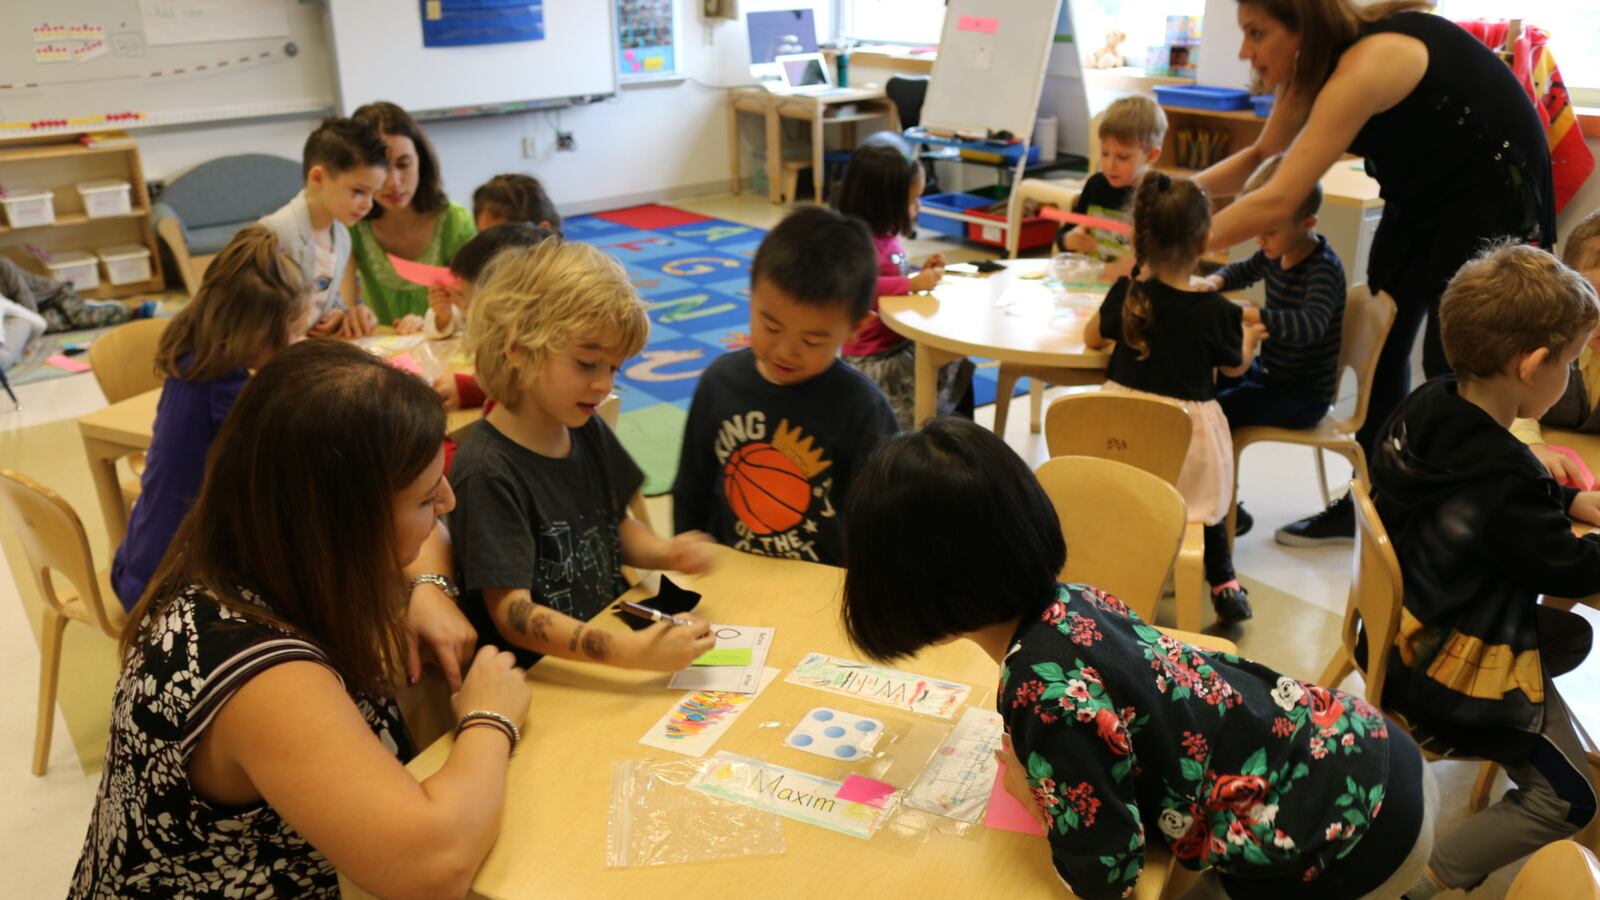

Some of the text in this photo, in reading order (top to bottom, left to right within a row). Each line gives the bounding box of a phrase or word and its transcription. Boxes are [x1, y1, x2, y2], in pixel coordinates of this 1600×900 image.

[660, 256, 742, 277] G
[714, 410, 767, 465] KING
[759, 529, 804, 553] THE
[747, 767, 836, 814] Maxim
